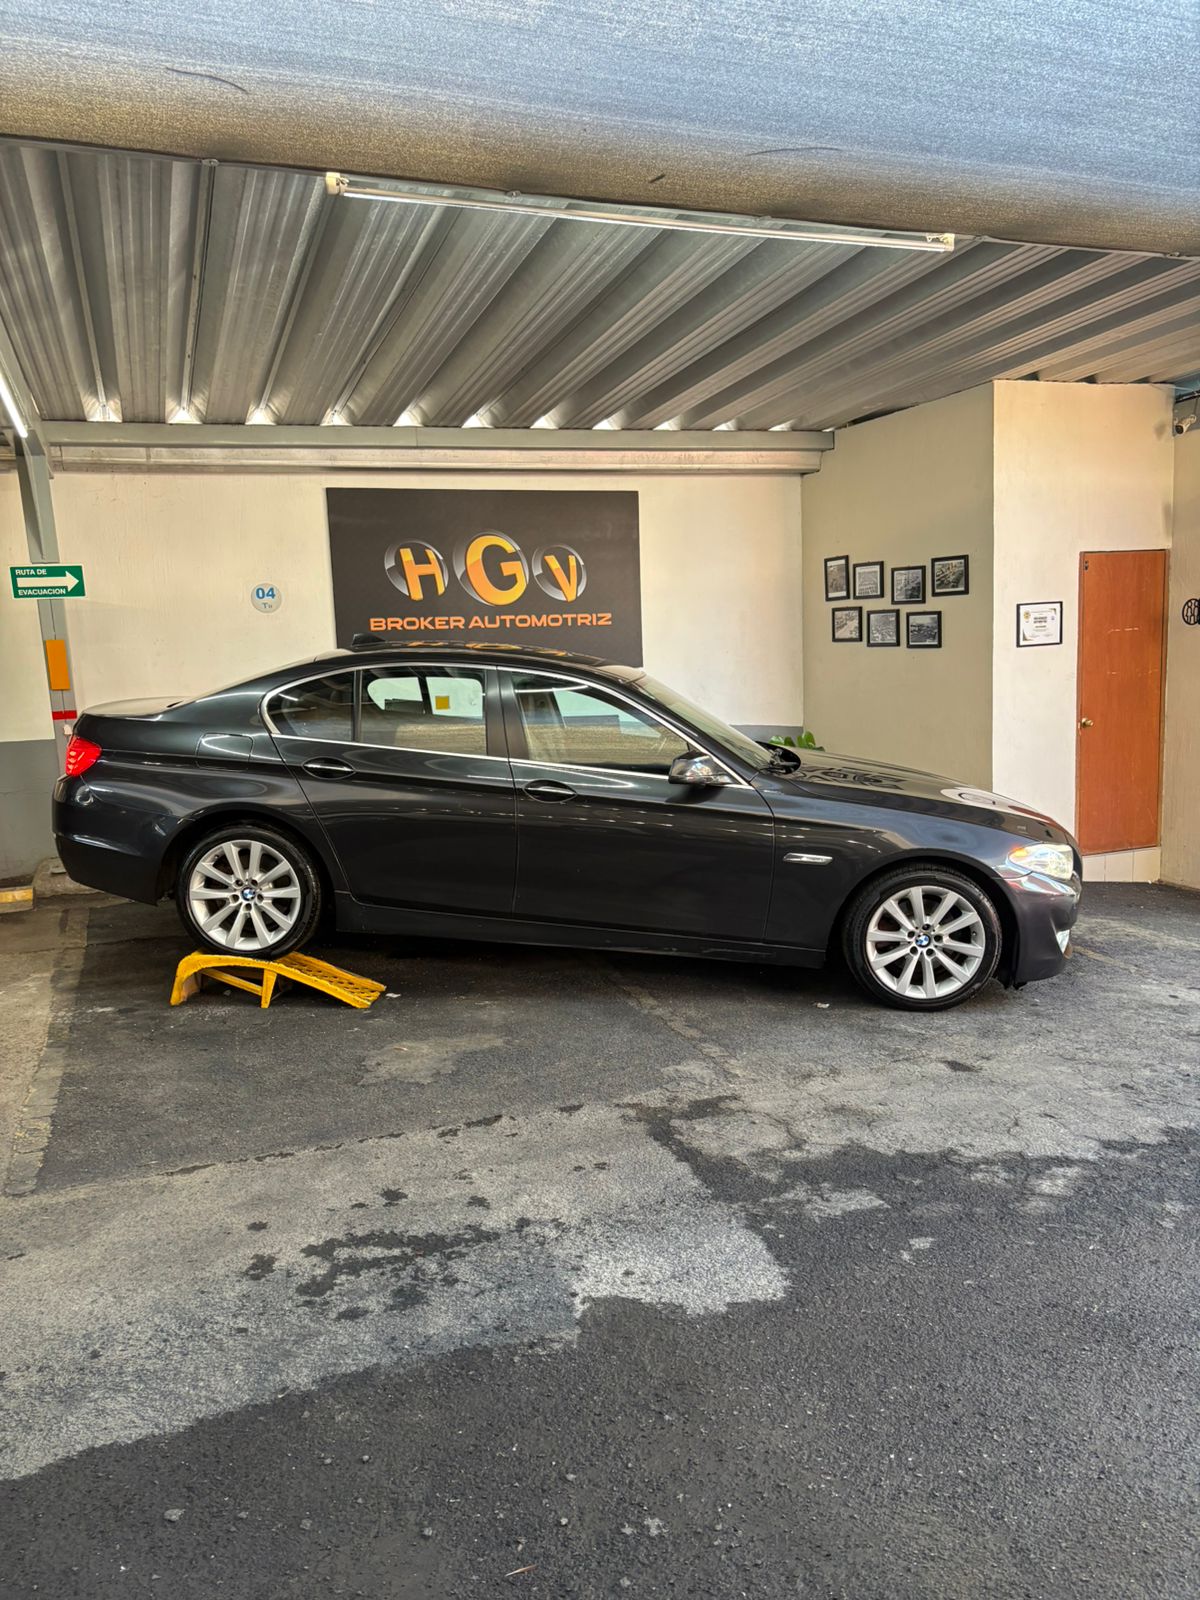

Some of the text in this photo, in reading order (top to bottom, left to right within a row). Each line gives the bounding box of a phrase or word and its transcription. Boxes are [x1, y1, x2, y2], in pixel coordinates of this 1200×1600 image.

[18, 588, 66, 596] EVACUACION
[255, 587, 276, 600] 04
[370, 613, 612, 631] BROKER AUTOMOTRIZ
